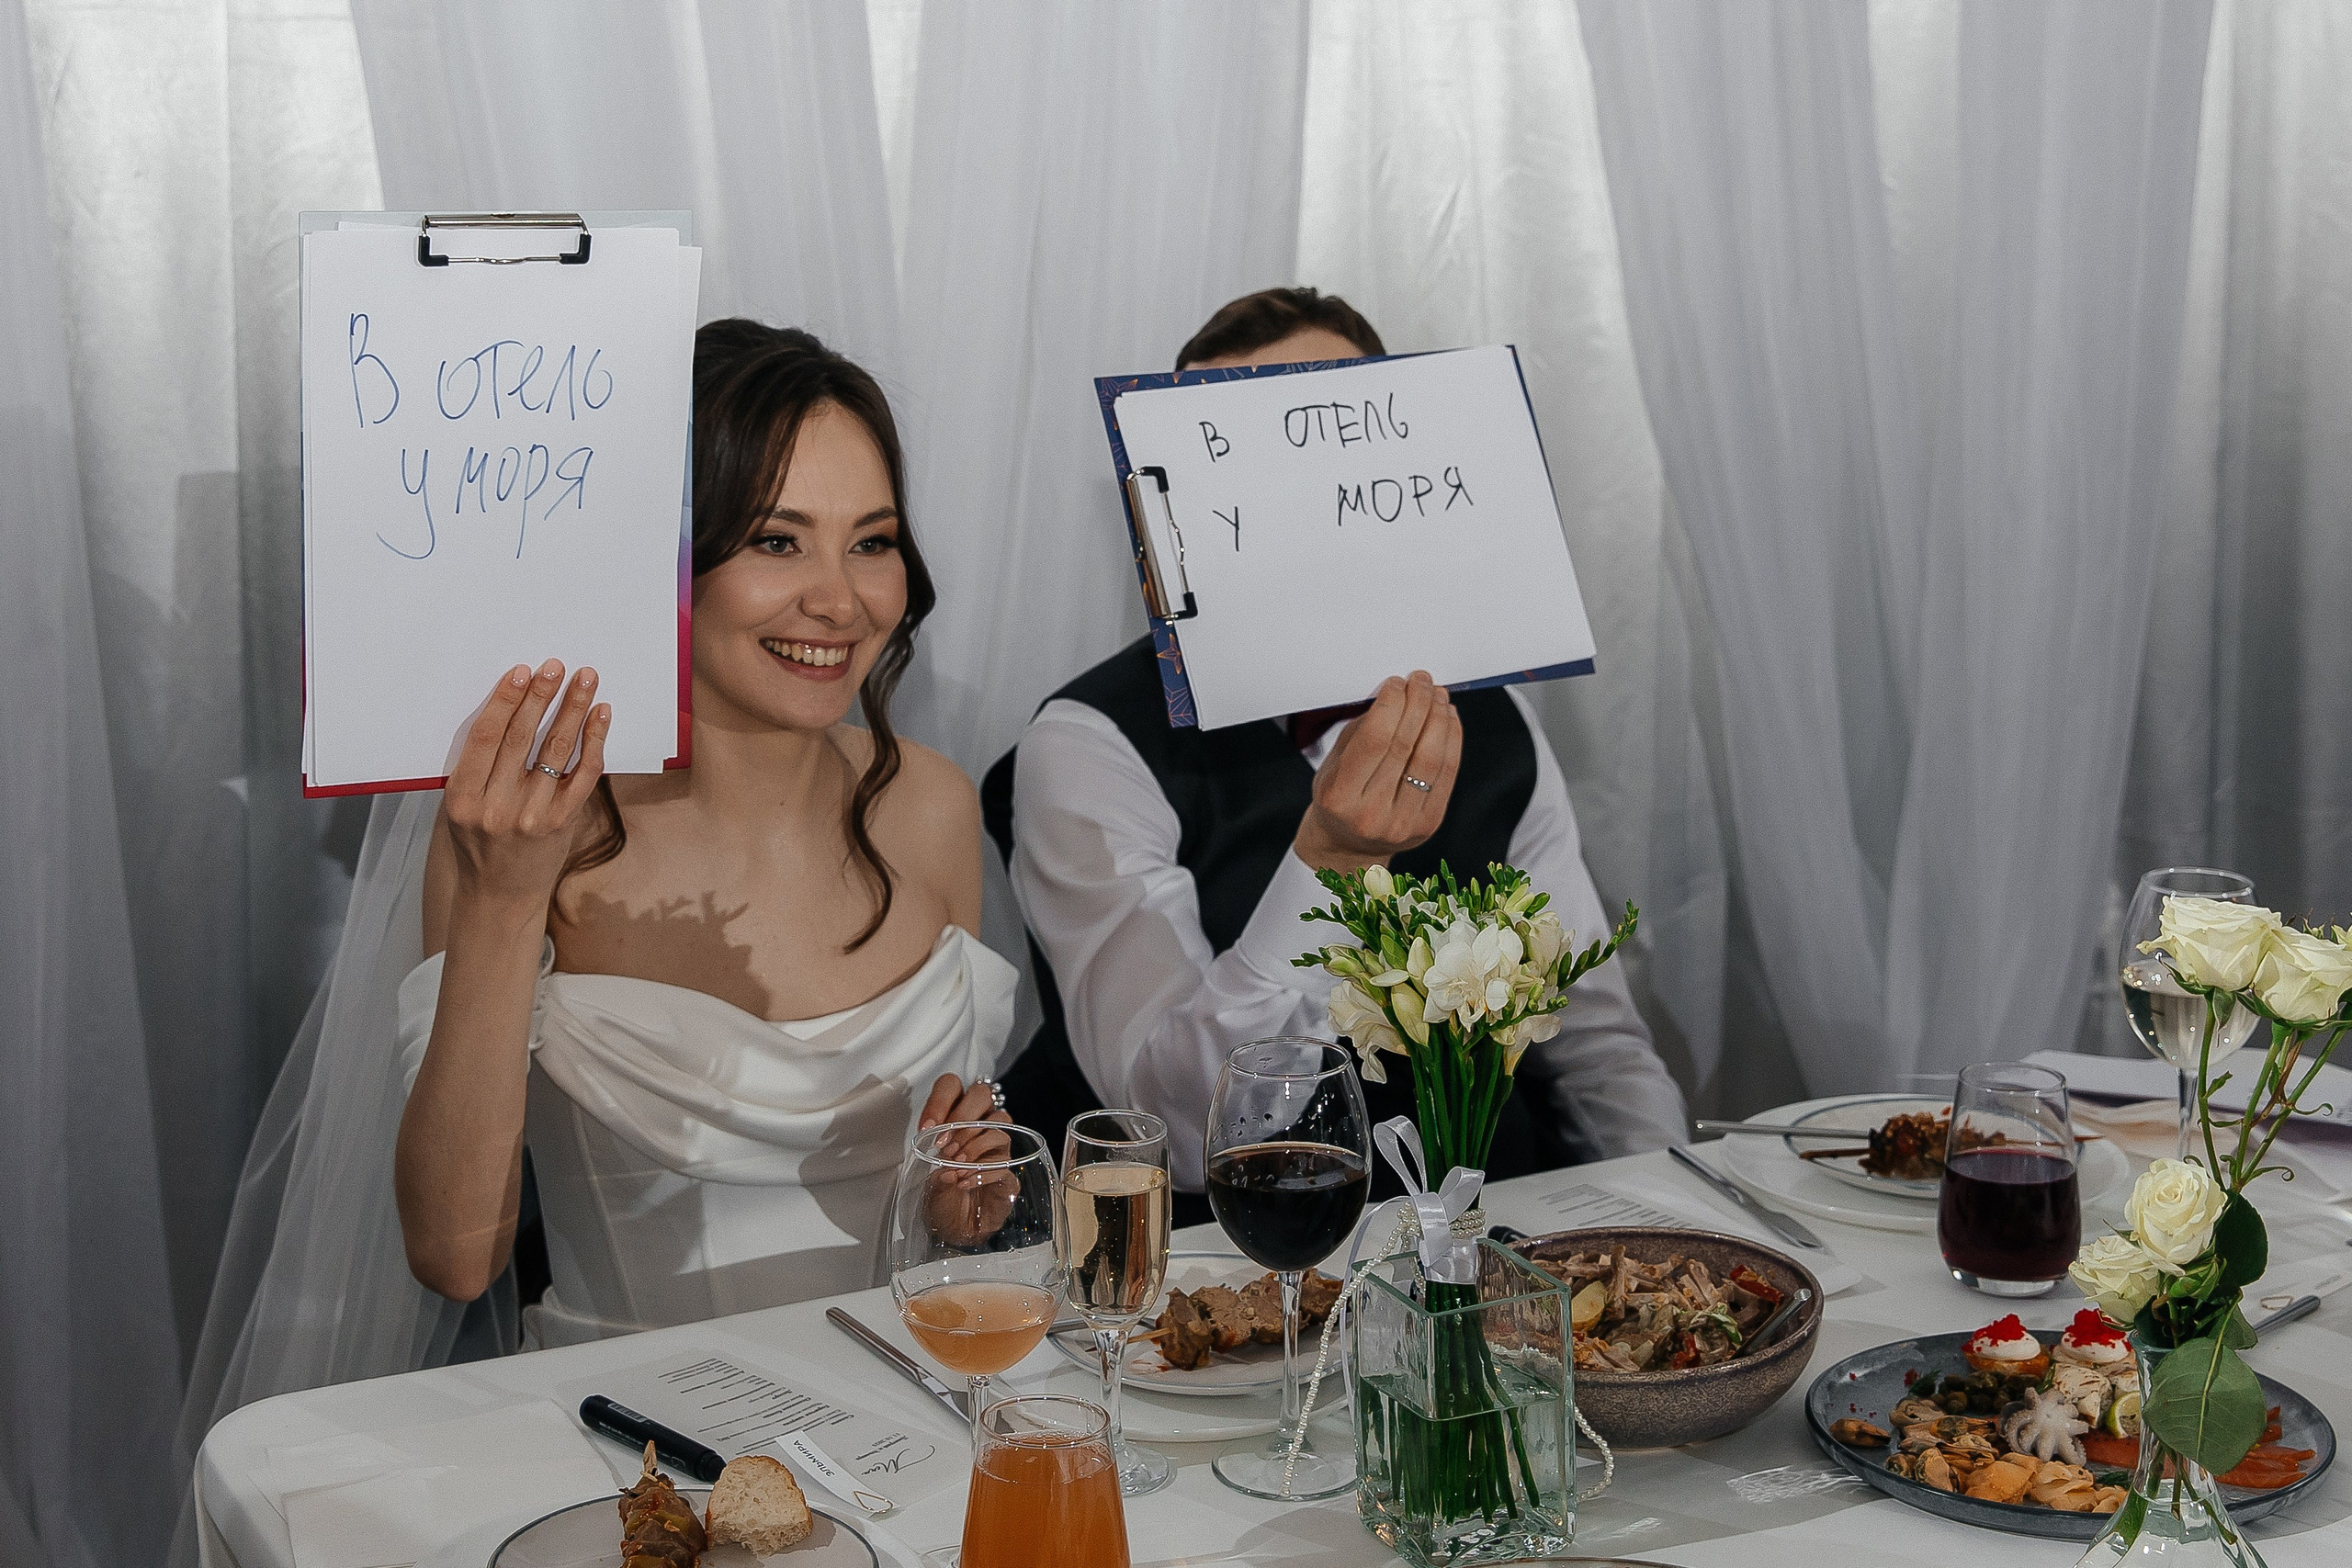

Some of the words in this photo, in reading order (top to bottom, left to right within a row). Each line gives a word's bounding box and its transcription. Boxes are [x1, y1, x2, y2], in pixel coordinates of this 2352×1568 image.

[348, 311, 401, 429] В
[435, 339, 614, 422] отель
[1199, 420, 1230, 463] В
[1284, 392, 1409, 448] ОТЕЛЬ
[454, 443, 595, 560] моря
[1211, 505, 1240, 552] У
[1337, 465, 1475, 527] МОРЯ
[793, 1439, 835, 1477] ЭЛЬМИРА
